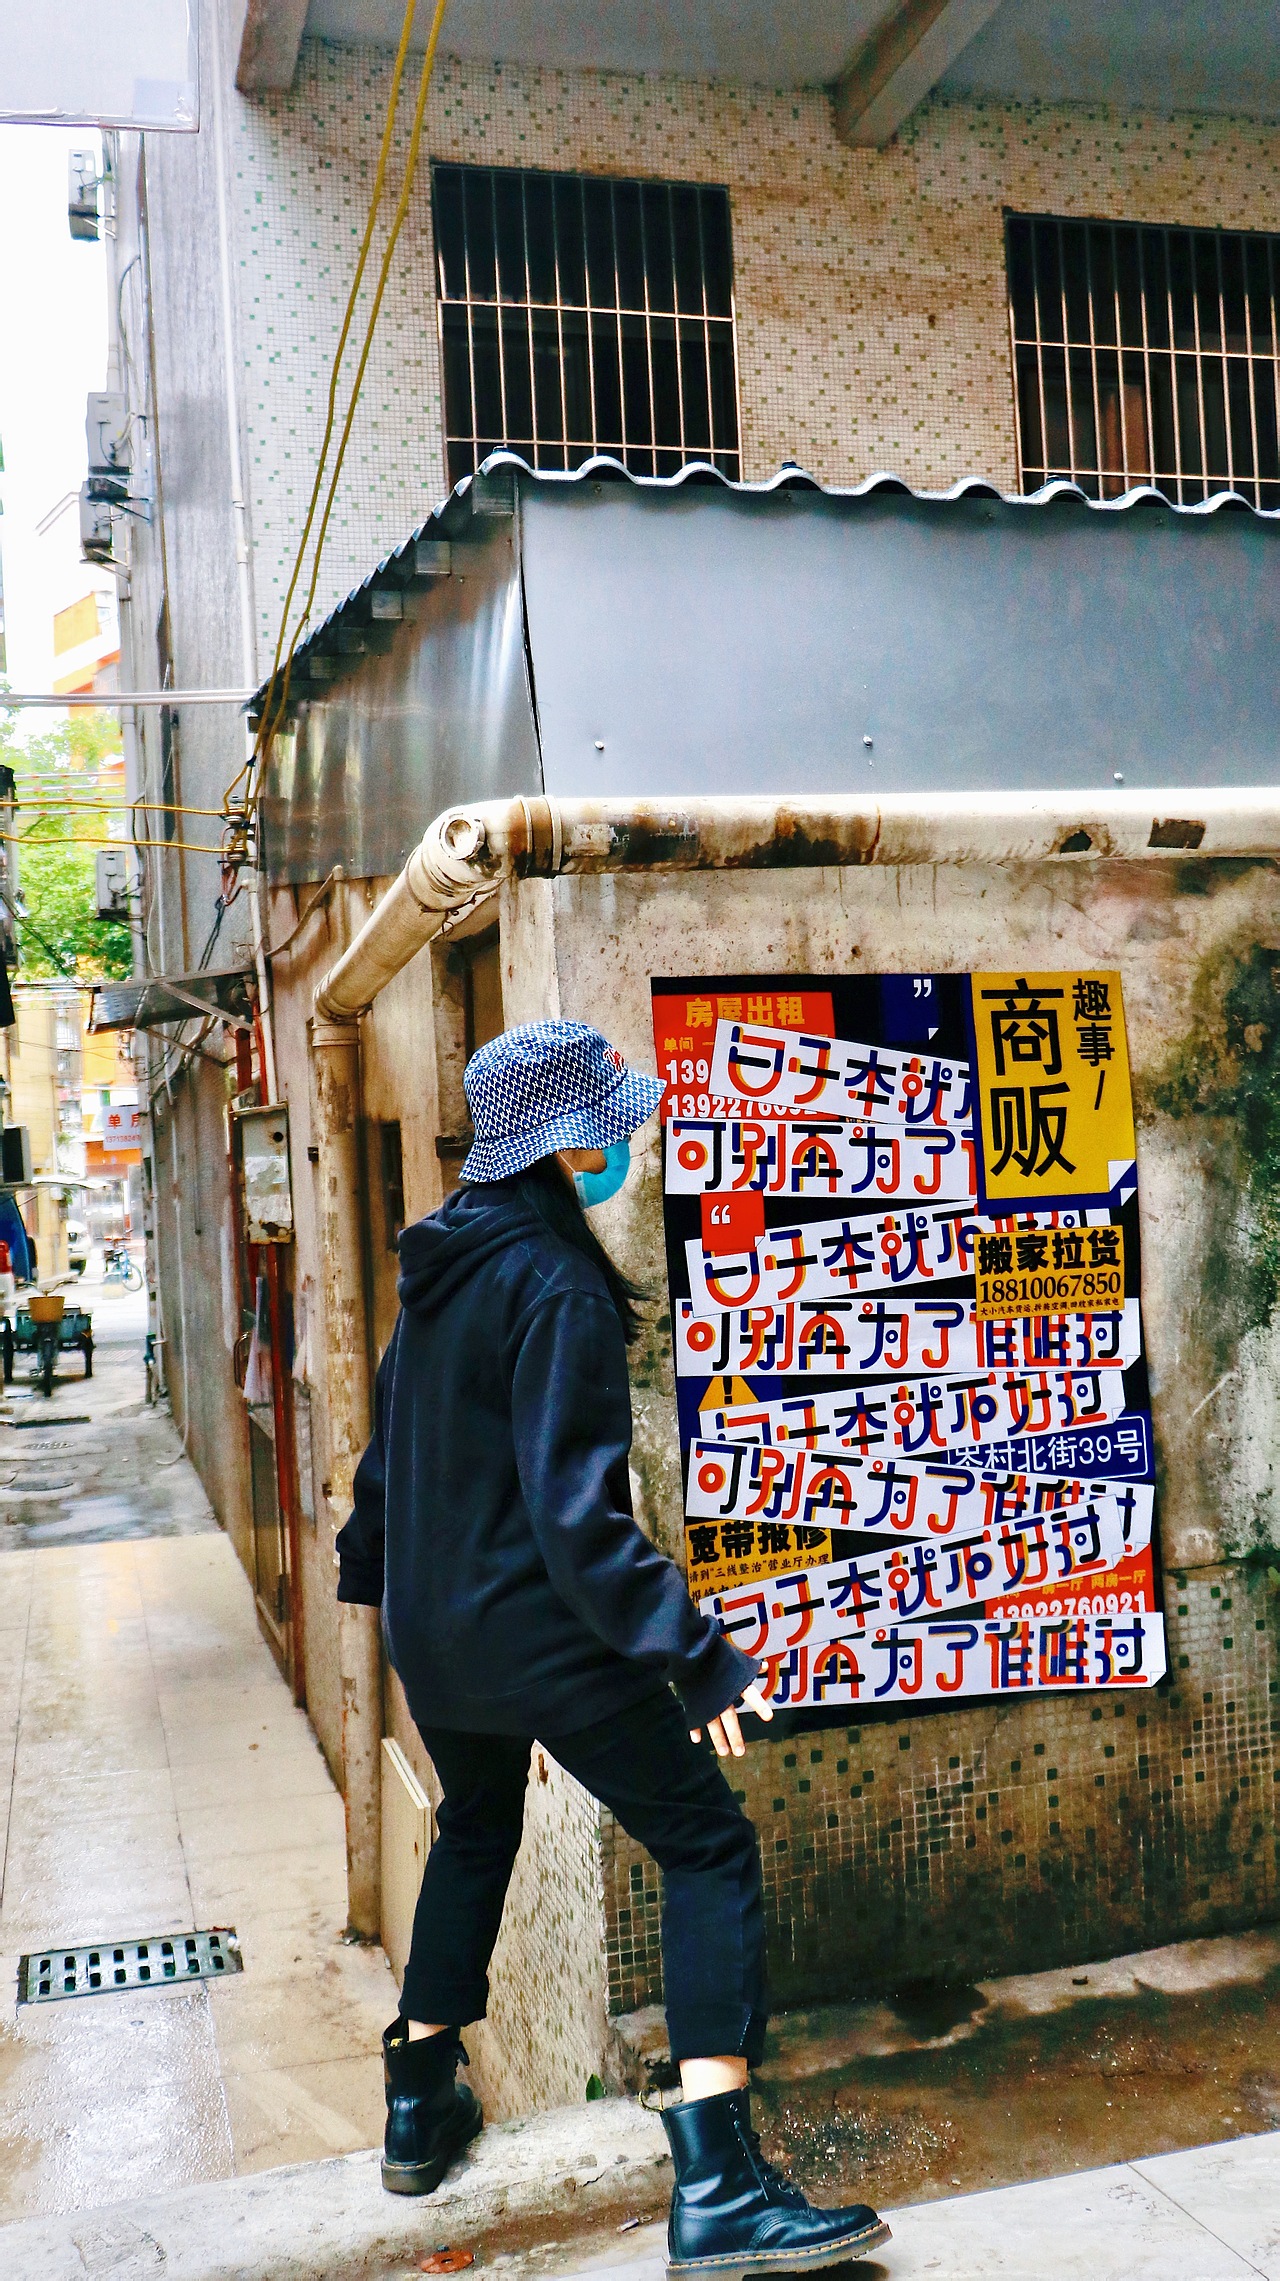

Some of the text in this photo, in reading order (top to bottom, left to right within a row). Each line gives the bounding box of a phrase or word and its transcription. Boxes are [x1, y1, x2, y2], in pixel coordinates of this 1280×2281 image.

[686, 997, 805, 1027] 房屋出租
[982, 979, 1076, 1178] 商贩
[673, 1119, 977, 1195] 可别再为了
[978, 1229, 1121, 1275] 搬家拉货
[980, 1272, 1121, 1303] 18810067850
[689, 1521, 828, 1566] 宽带报修
